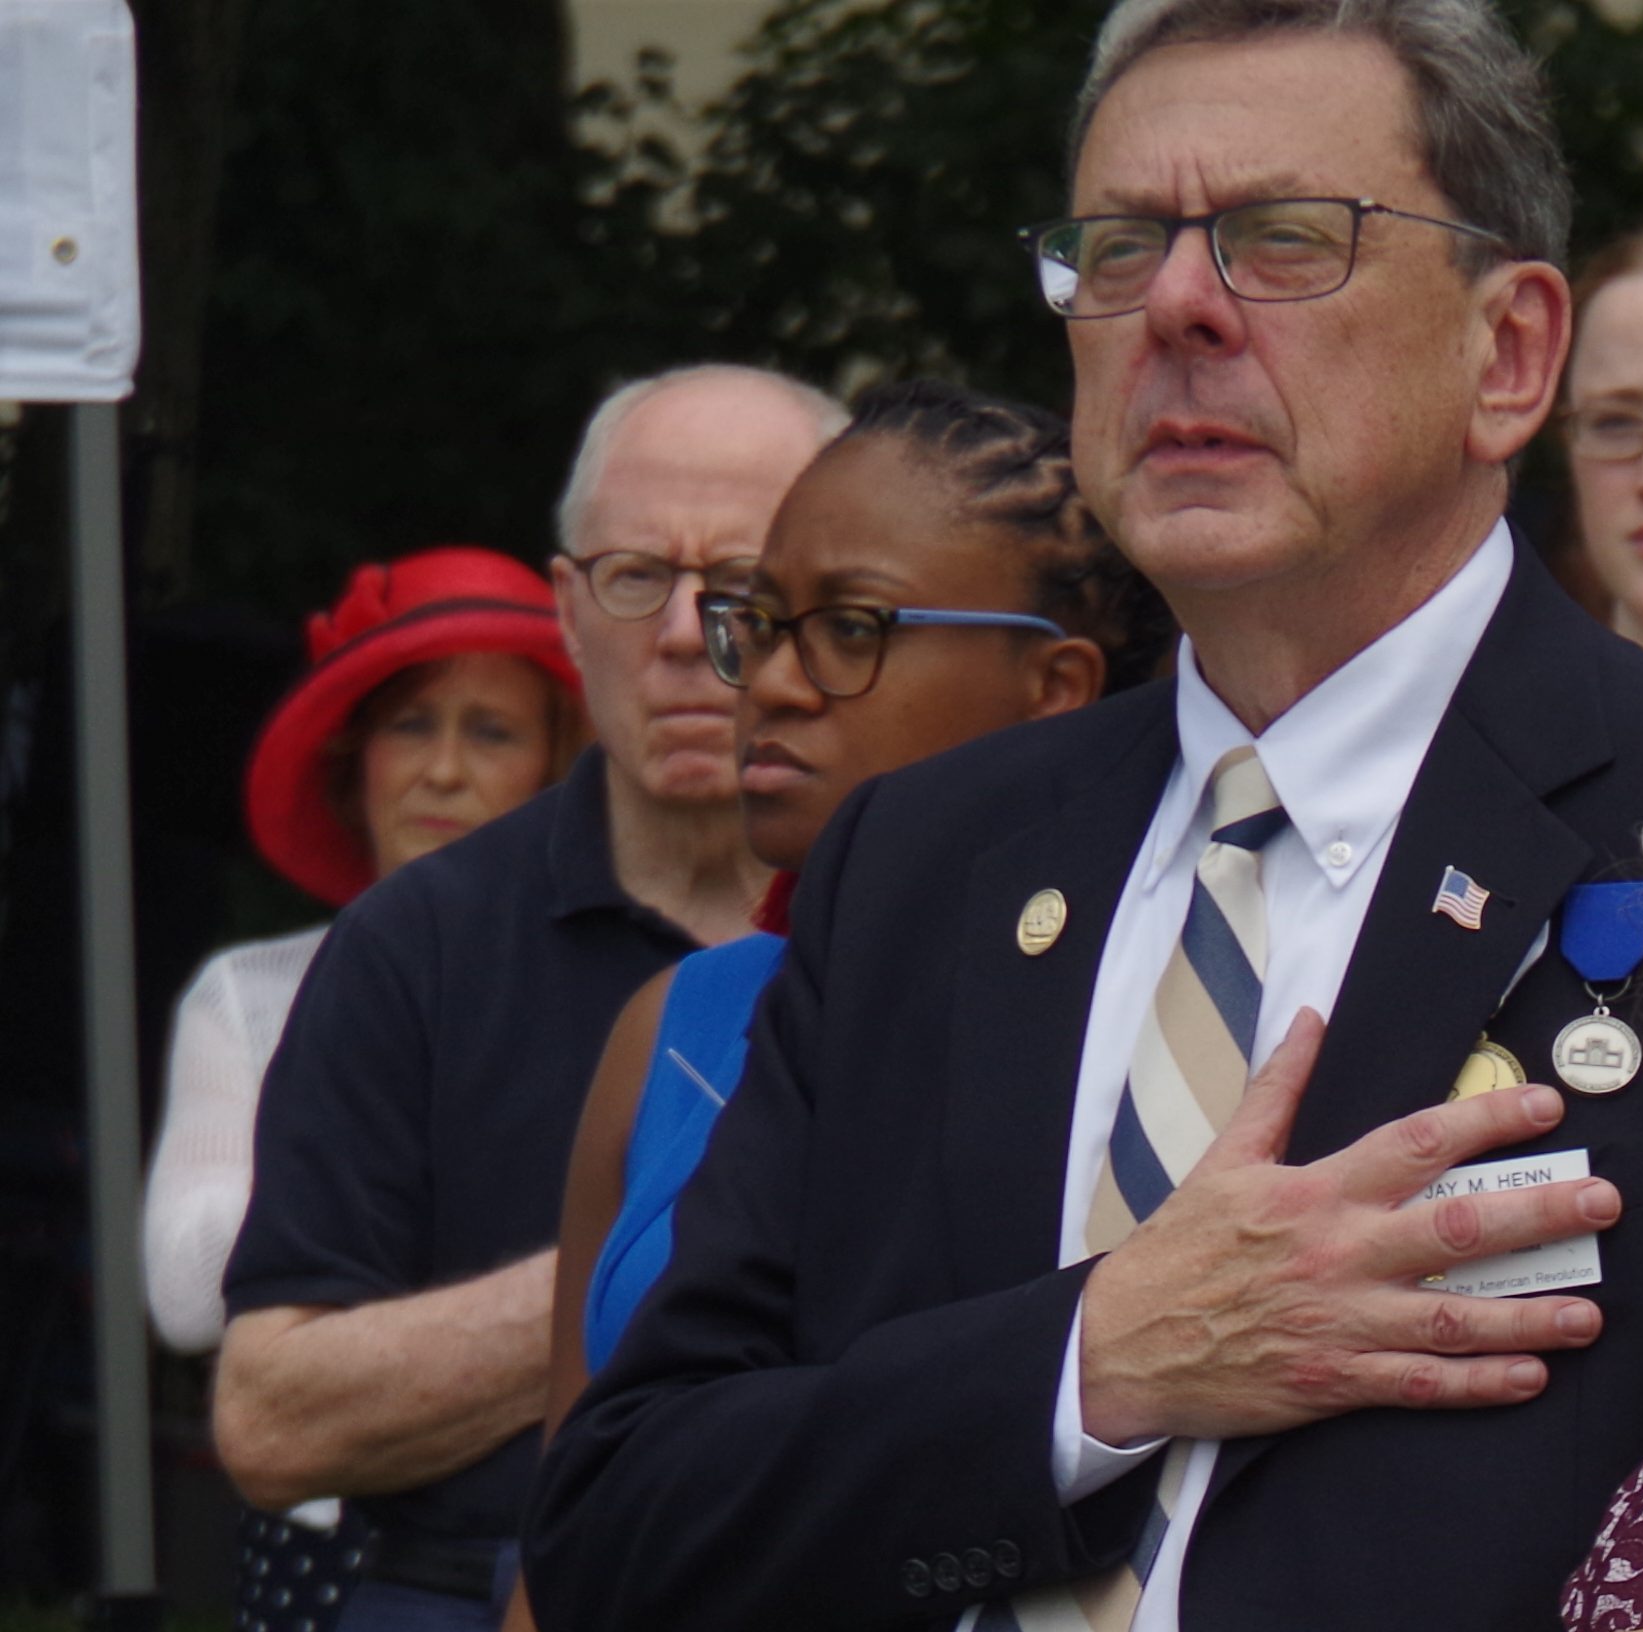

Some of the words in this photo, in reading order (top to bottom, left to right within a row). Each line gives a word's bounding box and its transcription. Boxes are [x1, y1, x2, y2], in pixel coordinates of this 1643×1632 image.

[1425, 1181, 1457, 1200] JAY
[1468, 1179, 1488, 1194] M.
[1498, 1168, 1552, 1189] HENN
[1479, 1275, 1530, 1292] American
[1536, 1266, 1595, 1285] Revolution
